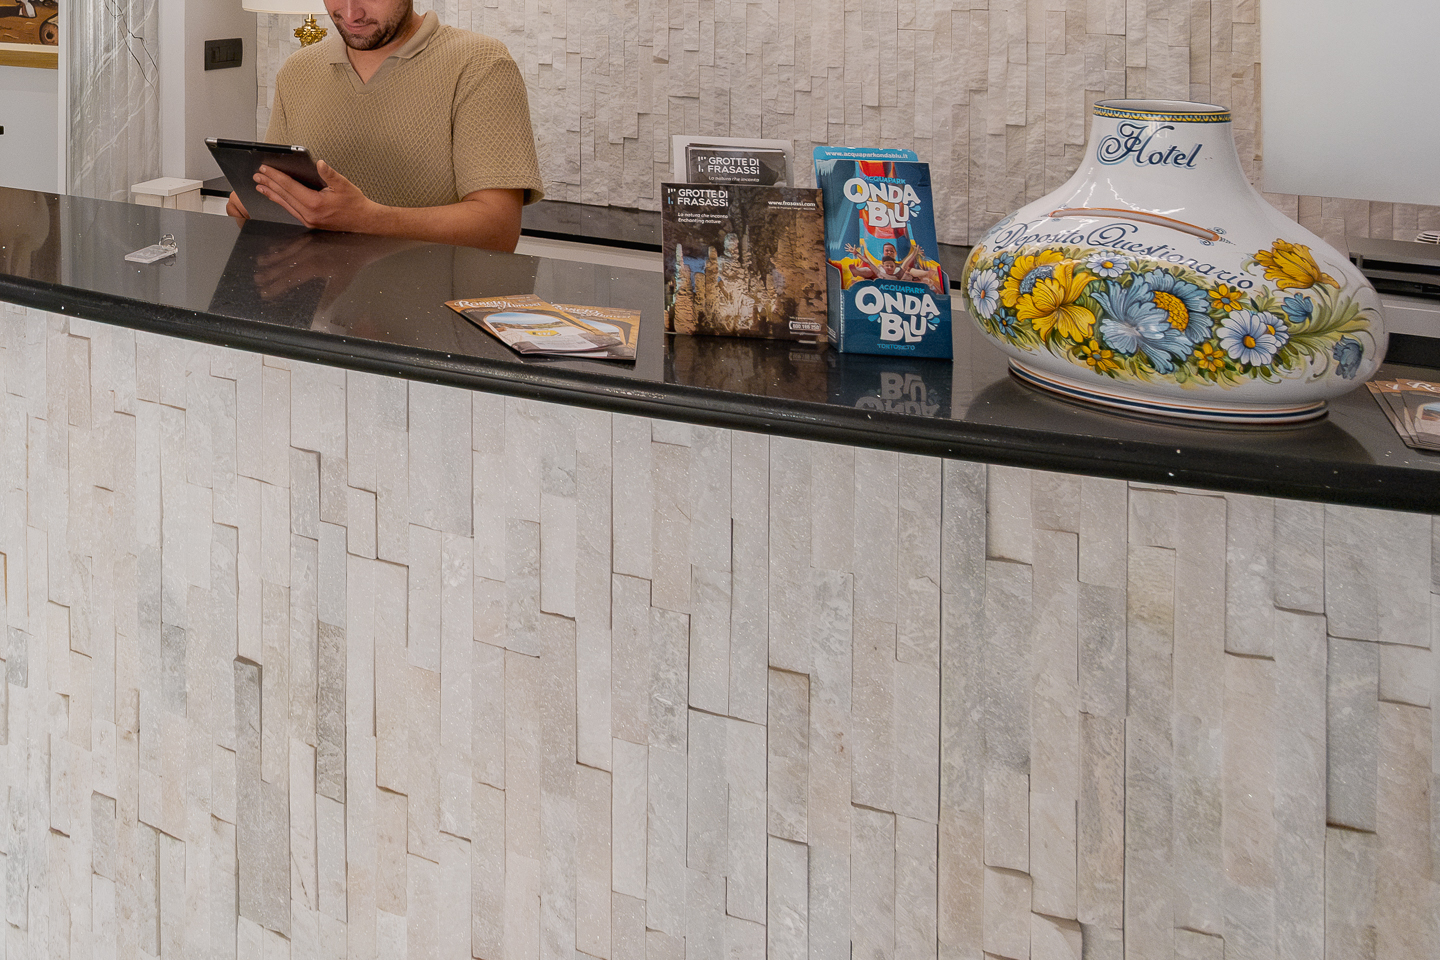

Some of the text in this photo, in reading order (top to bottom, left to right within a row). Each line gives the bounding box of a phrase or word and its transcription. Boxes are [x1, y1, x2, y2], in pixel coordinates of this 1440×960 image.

[1097, 121, 1203, 169] Hotel
[708, 156, 760, 167] GROTTE DI
[843, 178, 921, 204] ONDA
[863, 176, 906, 185] ACQUAPARK
[678, 189, 729, 199] GROTTE DI
[866, 201, 910, 228] BLU
[994, 222, 1254, 290] Deposito Questionario
[854, 286, 941, 316] ONDA
[878, 284, 925, 294] ACQUAPARK
[880, 312, 927, 343] BLU
[877, 343, 916, 351] TORTORETO
